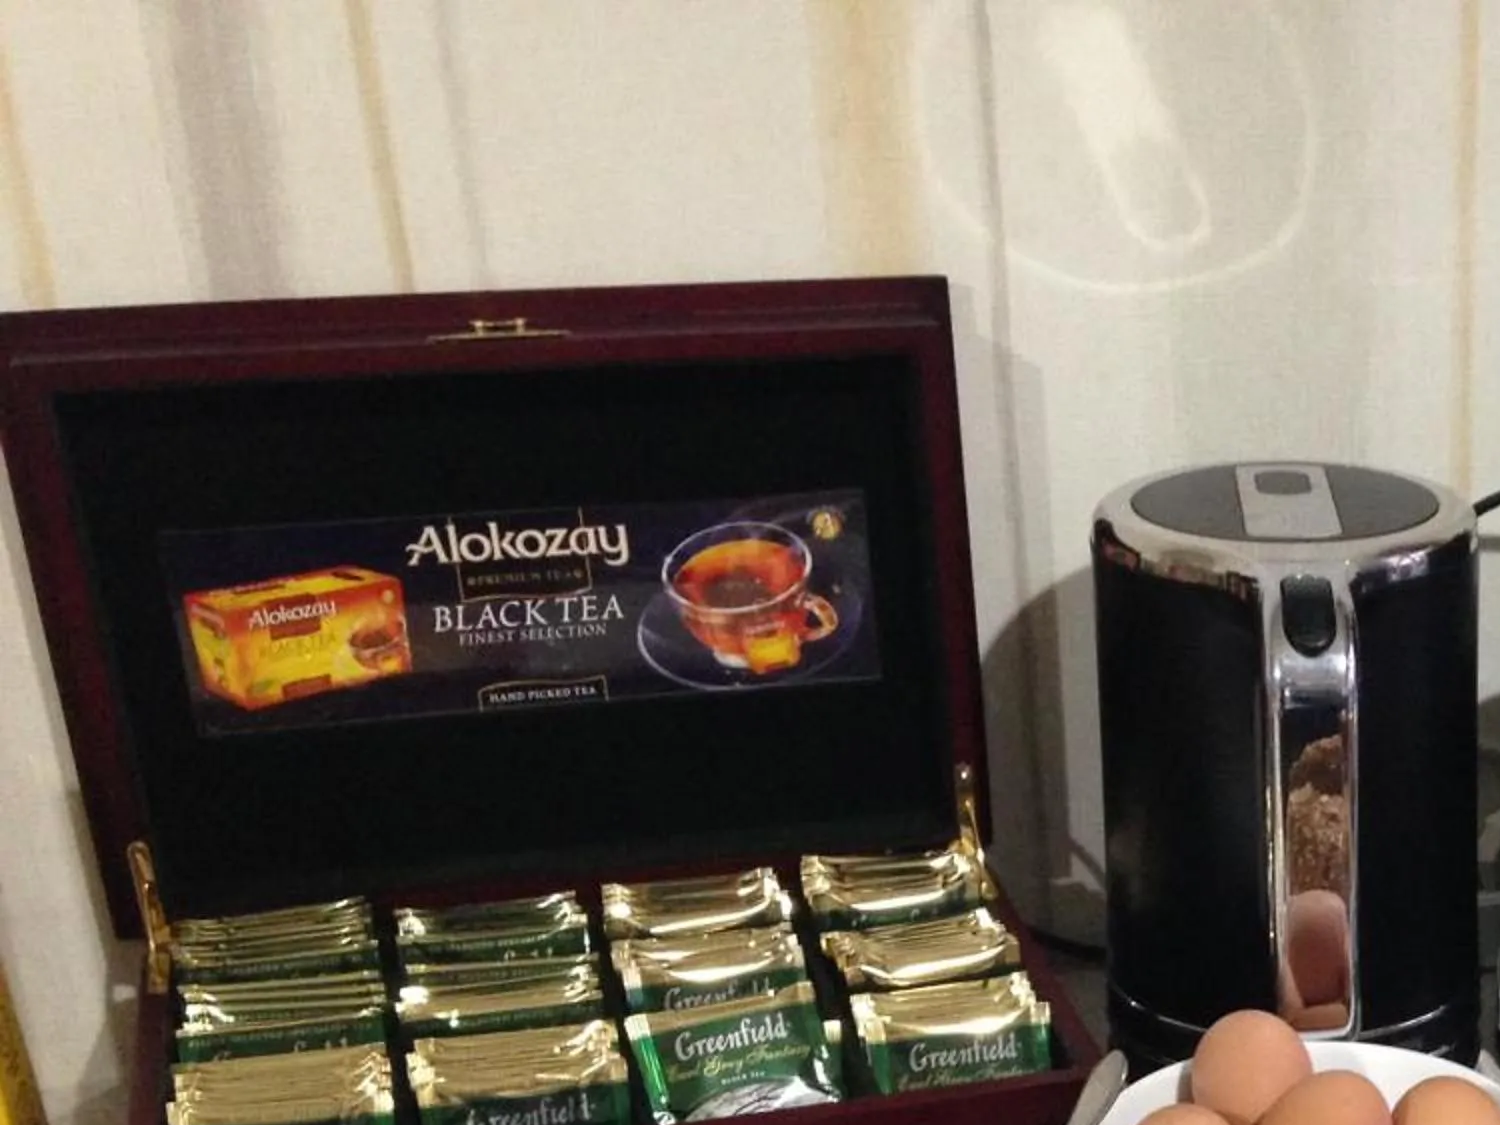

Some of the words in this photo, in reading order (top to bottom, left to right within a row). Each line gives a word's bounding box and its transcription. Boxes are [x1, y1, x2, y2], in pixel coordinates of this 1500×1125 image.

[405, 521, 630, 567] Alokozay
[250, 600, 337, 628] Alokozay
[433, 599, 548, 632] BLACK
[555, 594, 625, 624] TEA
[458, 629, 514, 647] FINEST
[519, 622, 607, 642] SELECTION
[489, 690, 526, 704] HAND
[527, 686, 571, 701] PICKED
[574, 684, 598, 697] TEA
[674, 1012, 789, 1061] Greenfield
[908, 1031, 1018, 1073] Greenfield
